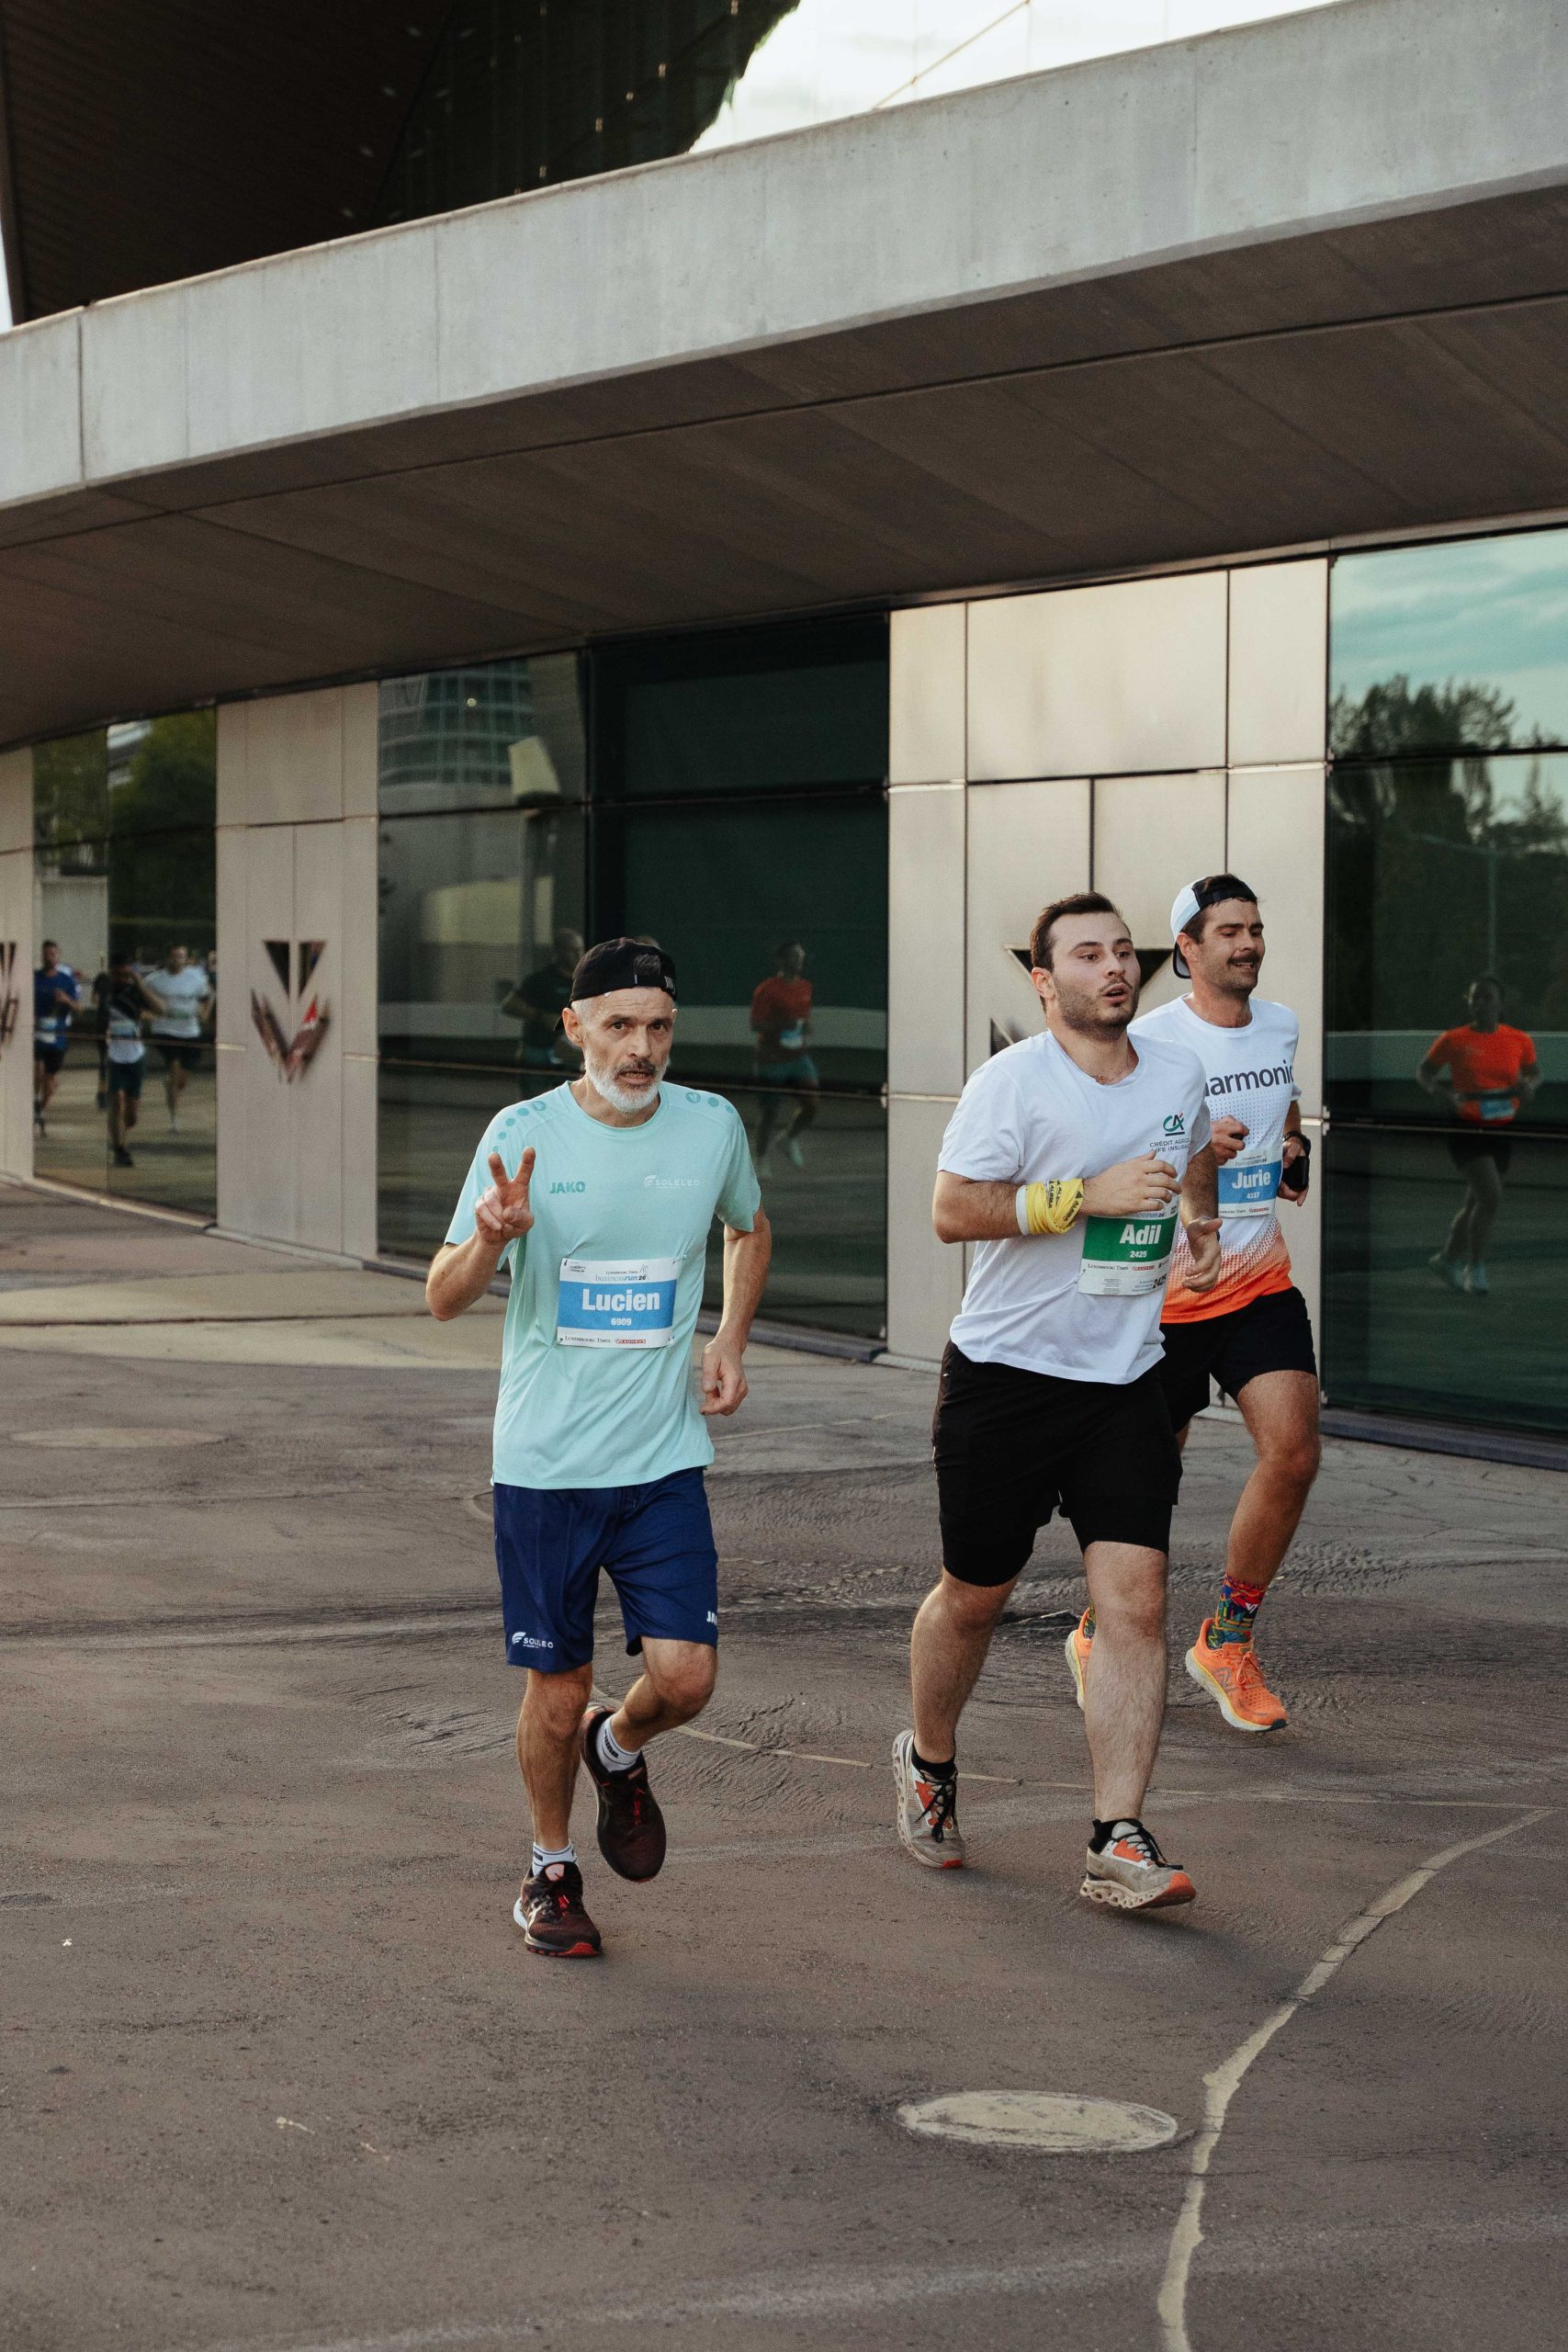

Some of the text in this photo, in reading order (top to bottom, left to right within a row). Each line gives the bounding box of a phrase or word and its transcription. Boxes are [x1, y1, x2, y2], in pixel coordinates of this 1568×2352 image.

[549, 1181, 585, 1194] JAKO
[1232, 1169, 1271, 1189] Jurie
[1119, 1224, 1162, 1245] Adil
[581, 1288, 660, 1312] Lucien
[611, 1317, 632, 1326] 6909
